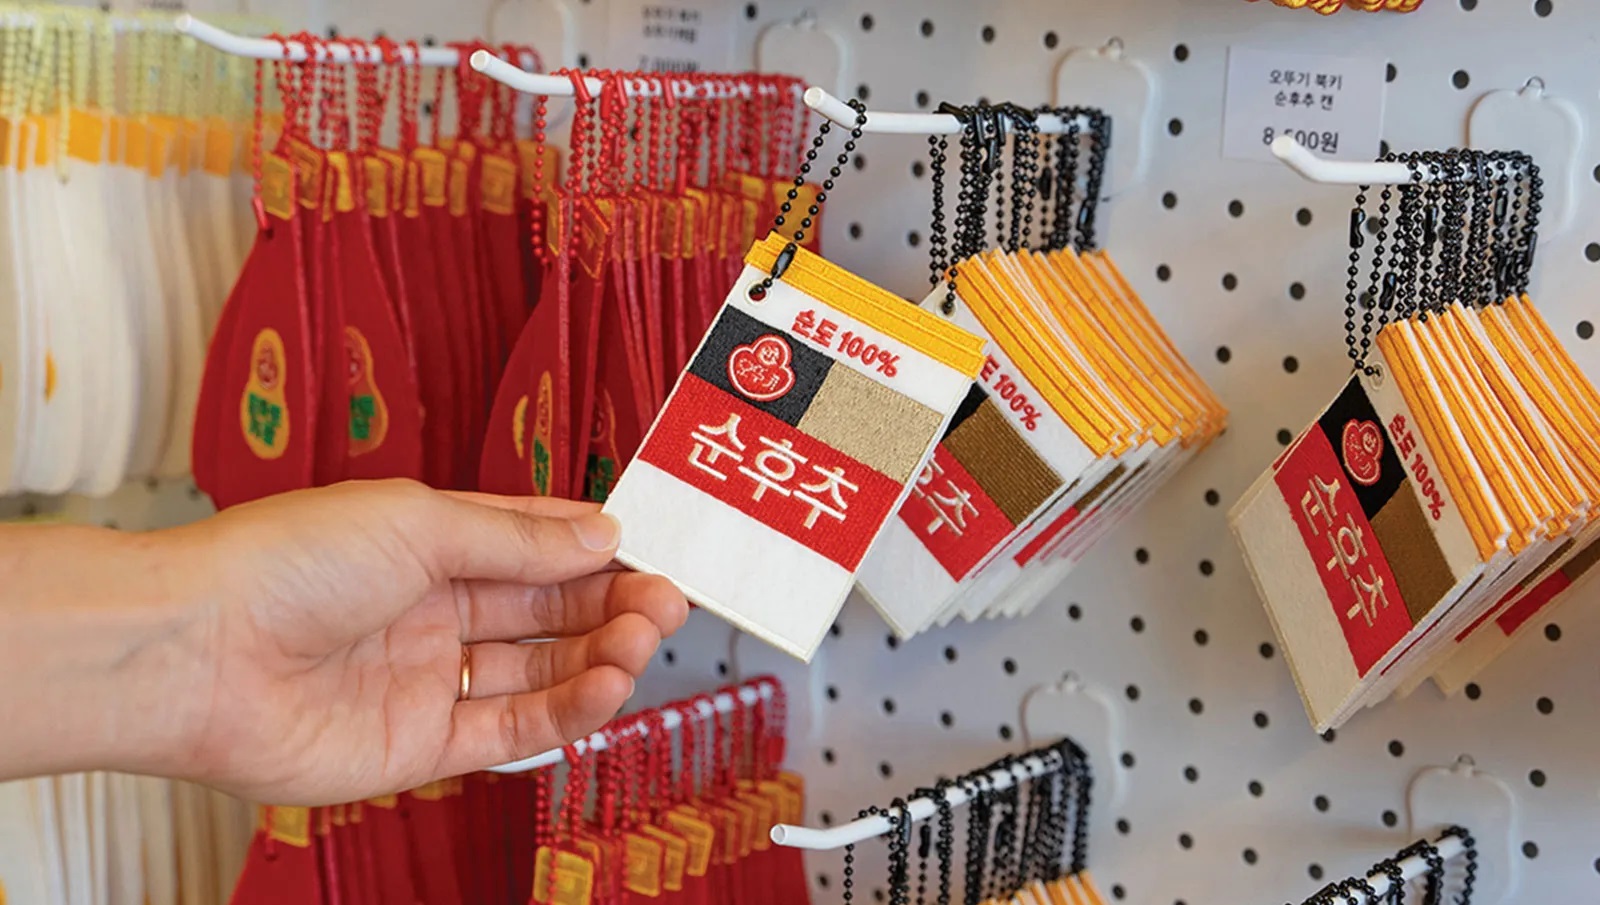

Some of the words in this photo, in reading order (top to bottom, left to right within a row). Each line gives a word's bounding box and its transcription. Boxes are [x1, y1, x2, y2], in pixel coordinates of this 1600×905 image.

[1269, 69, 1310, 87] 오뚜기
[1274, 91, 1314, 108] 순후추
[1320, 94, 1334, 111] 캔
[1262, 126, 1339, 154] 800원
[792, 310, 838, 348] 순도
[837, 331, 900, 378] 100%
[993, 374, 1042, 431] 100%
[687, 412, 859, 530] 순후추
[1388, 413, 1417, 461] 순도
[1410, 453, 1446, 521] 100%
[1300, 473, 1389, 628] 순후추
